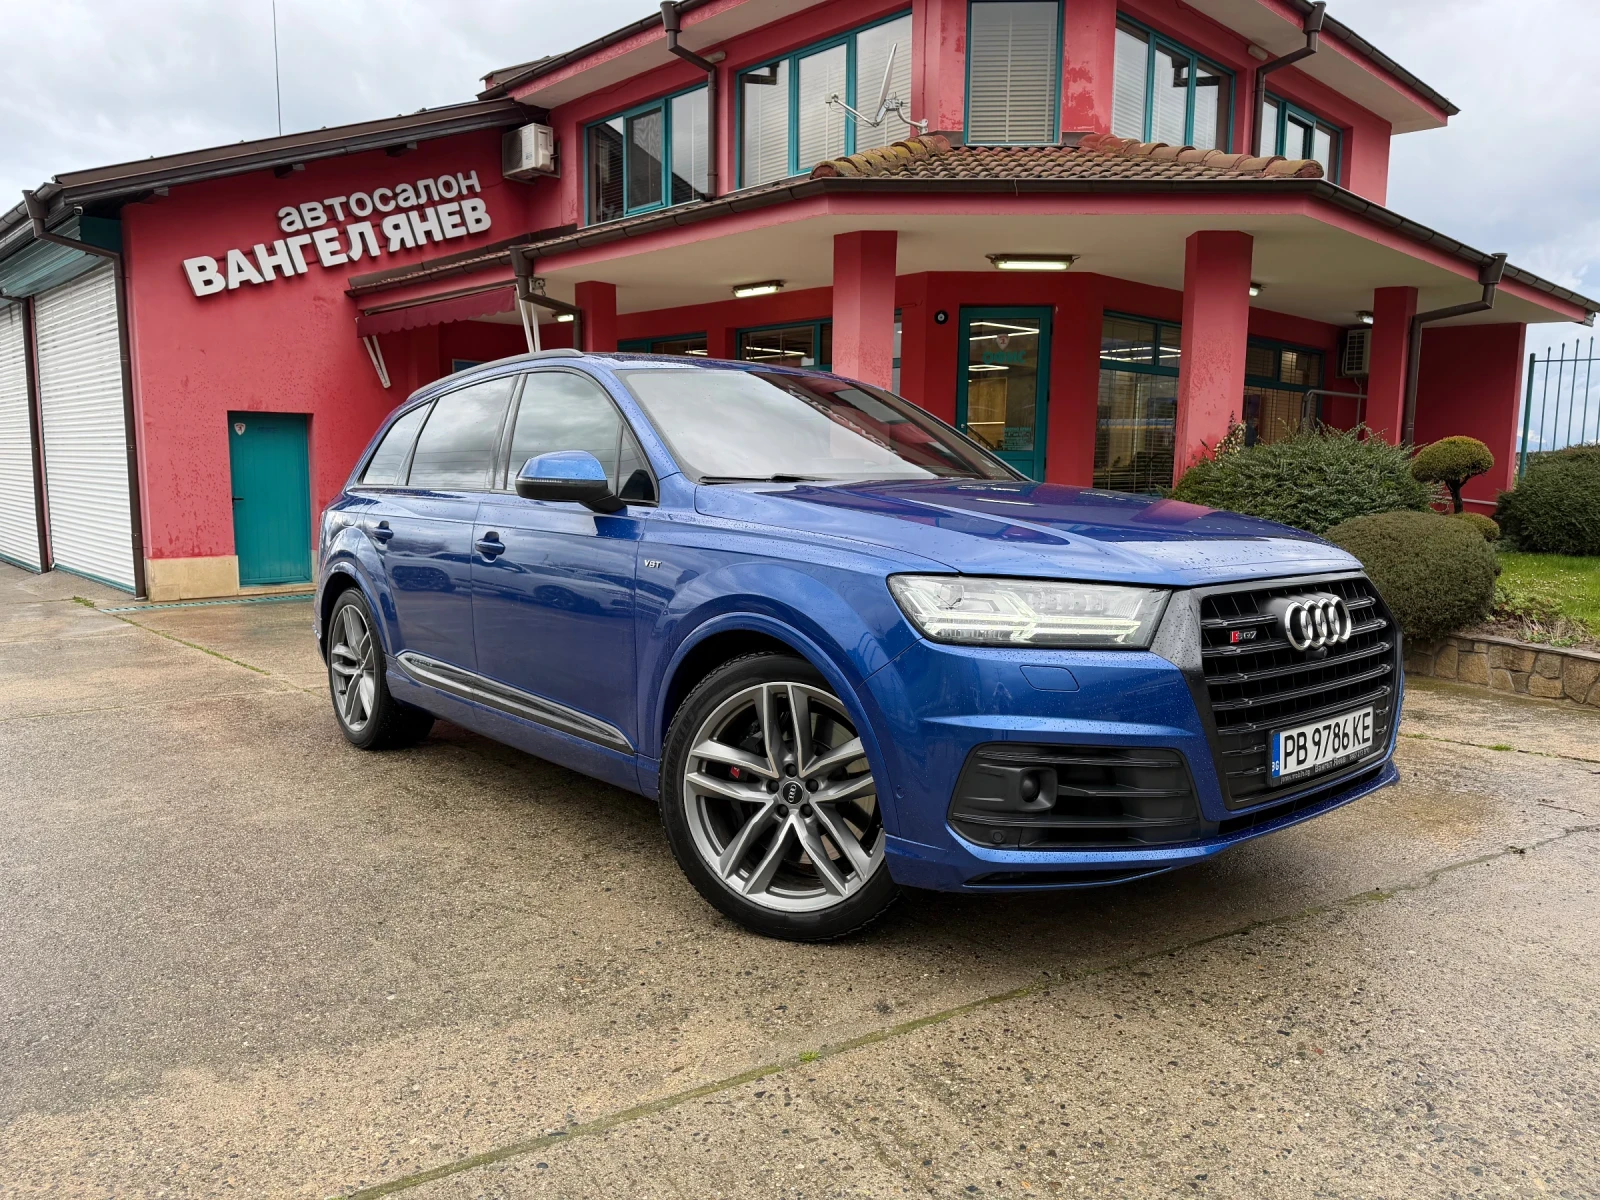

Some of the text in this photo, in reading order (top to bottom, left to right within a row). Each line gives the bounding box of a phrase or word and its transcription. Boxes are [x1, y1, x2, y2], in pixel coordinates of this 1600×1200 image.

[277, 169, 481, 233] автосалон
[182, 197, 492, 297] ВАНГЕЛ ЯНЕВ
[982, 350, 1027, 365] ОФИС
[644, 559, 662, 569] V8T
[1283, 711, 1371, 770] PB 9786 KE
